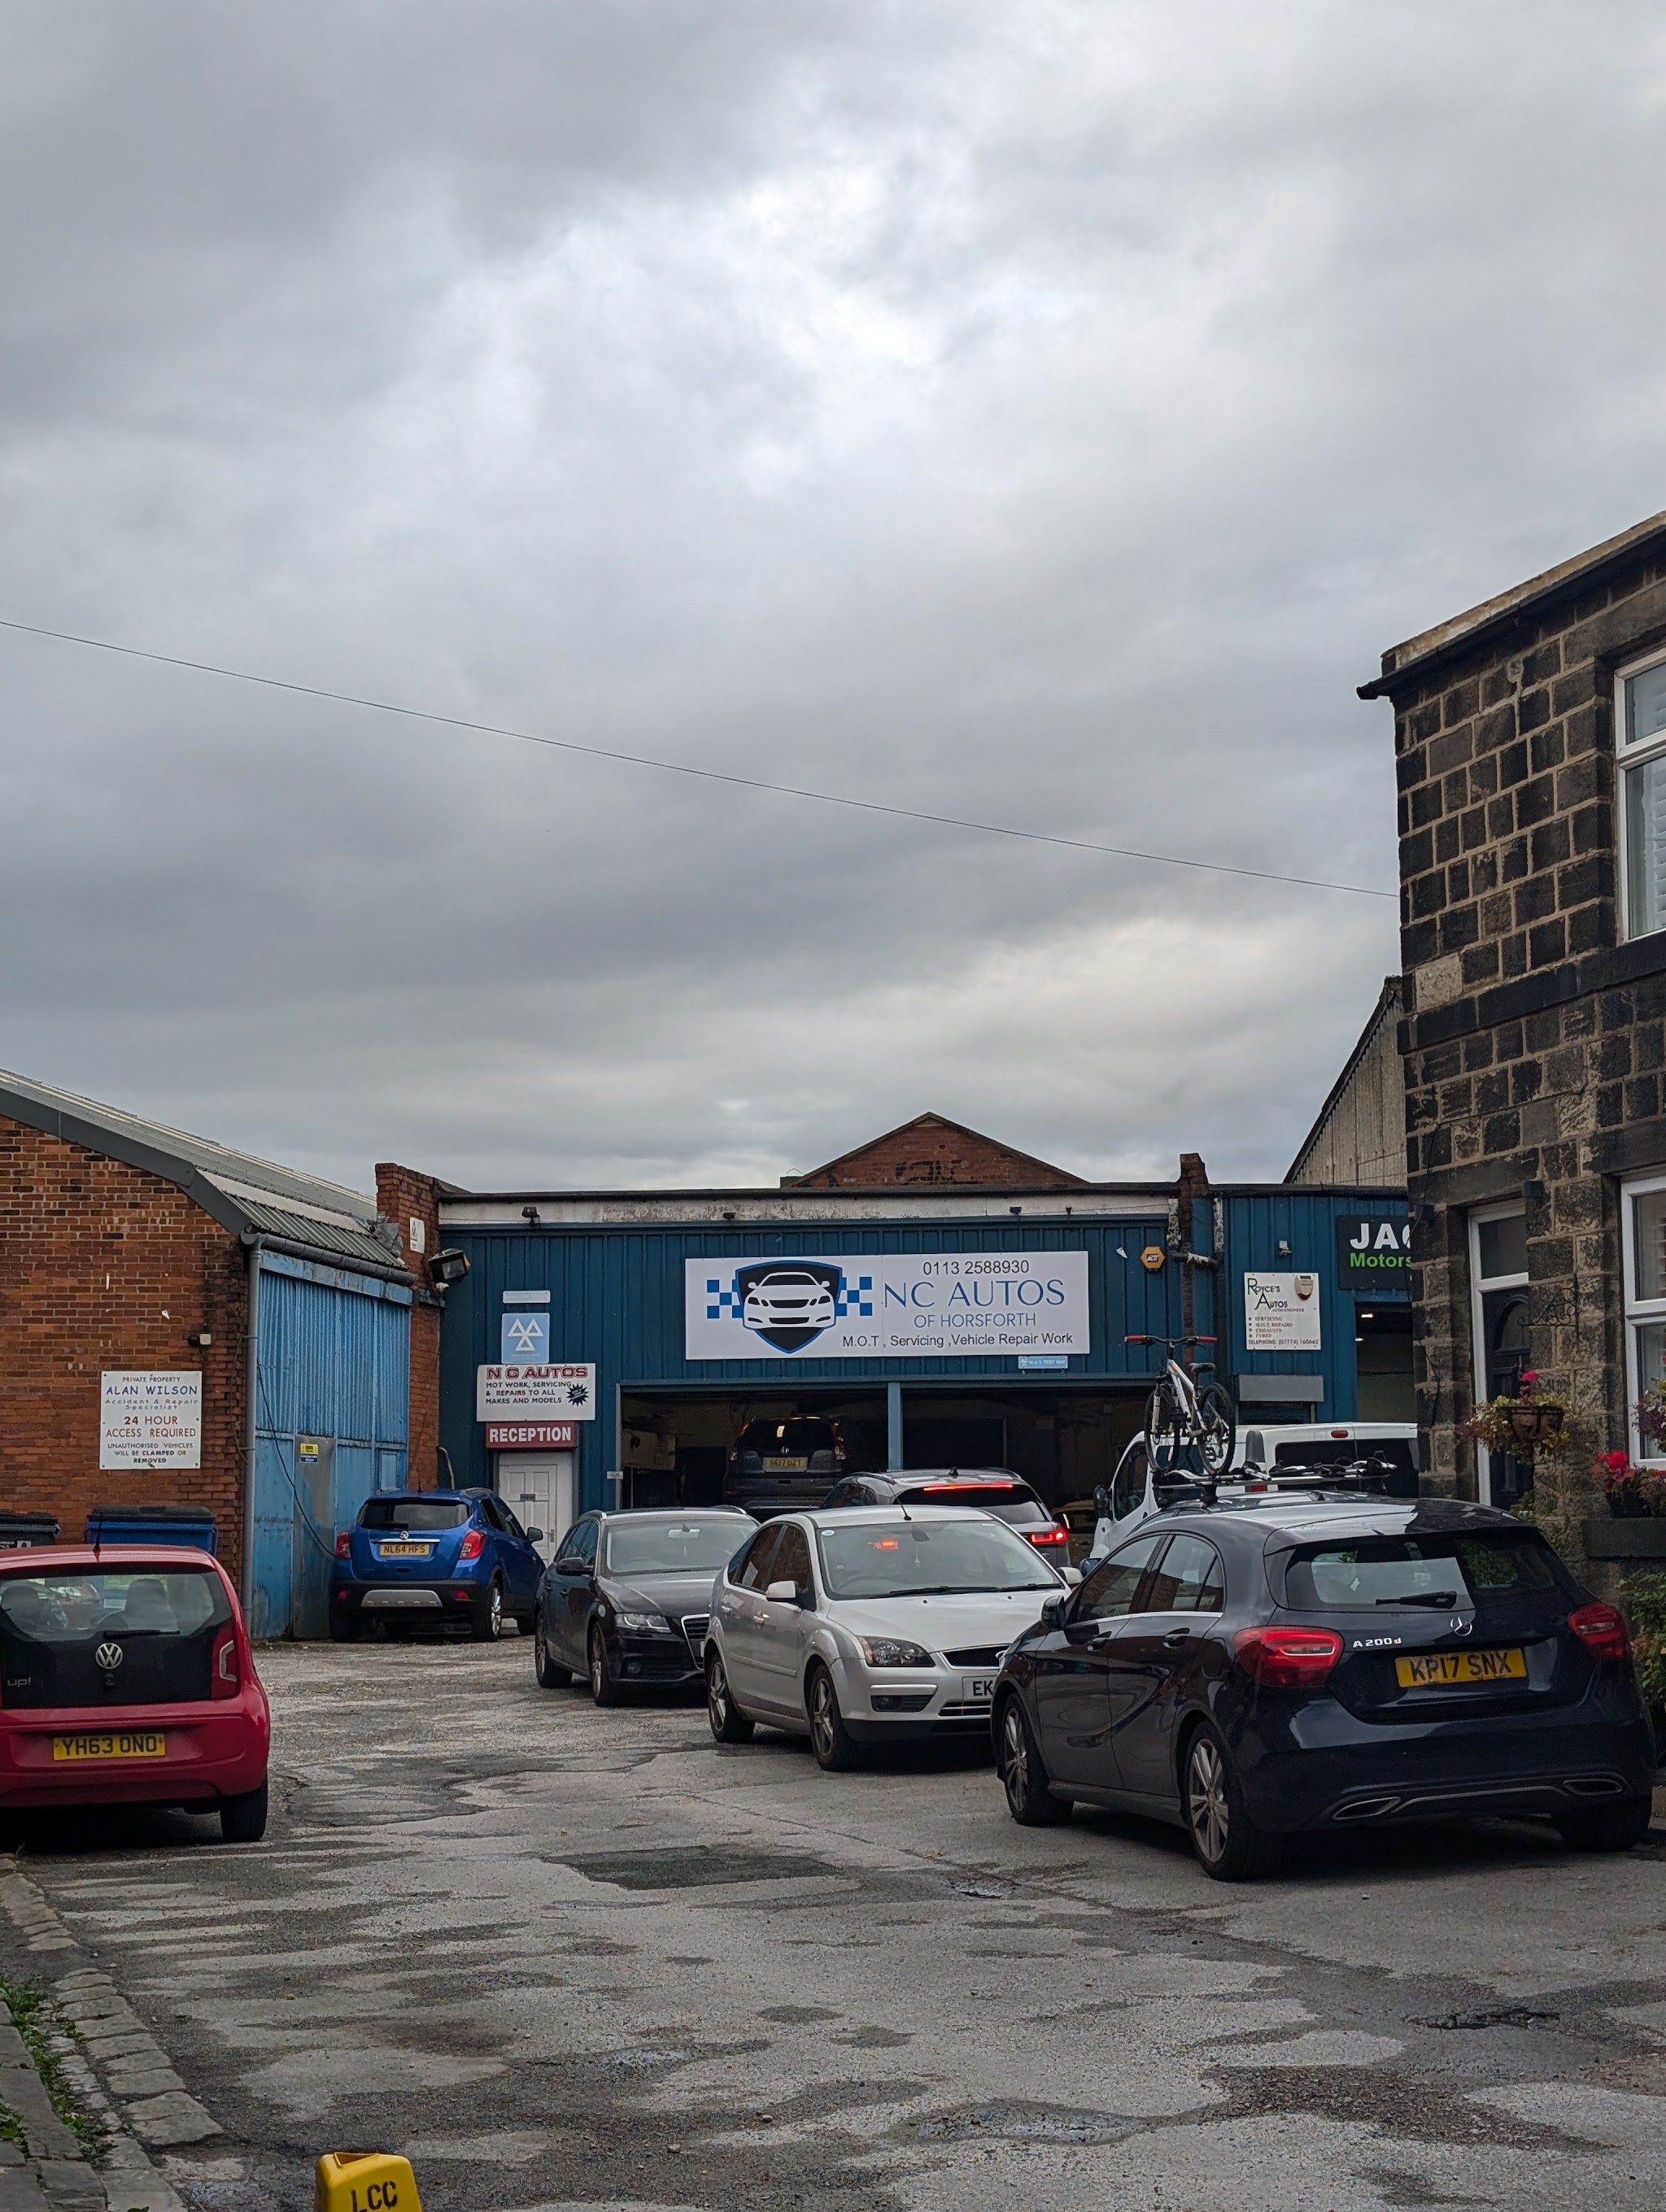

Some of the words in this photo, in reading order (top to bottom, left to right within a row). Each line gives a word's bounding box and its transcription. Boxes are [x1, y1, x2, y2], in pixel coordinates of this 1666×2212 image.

[922, 1261, 960, 1275] 0113
[964, 1260, 1030, 1274] 2588930
[884, 1281, 935, 1308] NC
[948, 1278, 1065, 1307] AUTOS
[914, 1314, 935, 1328] OF
[940, 1313, 1036, 1328] HORSFORTH
[890, 1335, 944, 1348] Servicing
[999, 1333, 1038, 1347] Repair
[1040, 1332, 1074, 1344] Work
[486, 1367, 502, 1380] N
[521, 1366, 588, 1379] AUTOS
[106, 1385, 138, 1396] ALAN
[146, 1385, 198, 1396] WILSON
[124, 1416, 139, 1426] 24
[145, 1416, 178, 1426] HOUR
[106, 1428, 142, 1438] ACCESS
[150, 1428, 196, 1439] REQUIRED
[489, 1426, 571, 1443] RECEPTION
[383, 1545, 406, 1554] NL64
[408, 1544, 425, 1553] HFS
[1410, 1656, 1460, 1682] KP17
[1467, 1652, 1512, 1677] SNX
[7, 1676, 32, 1687] up!
[62, 1737, 114, 1756] YH63
[120, 1735, 157, 1753] ONO
[351, 2180, 398, 2212] LCC
